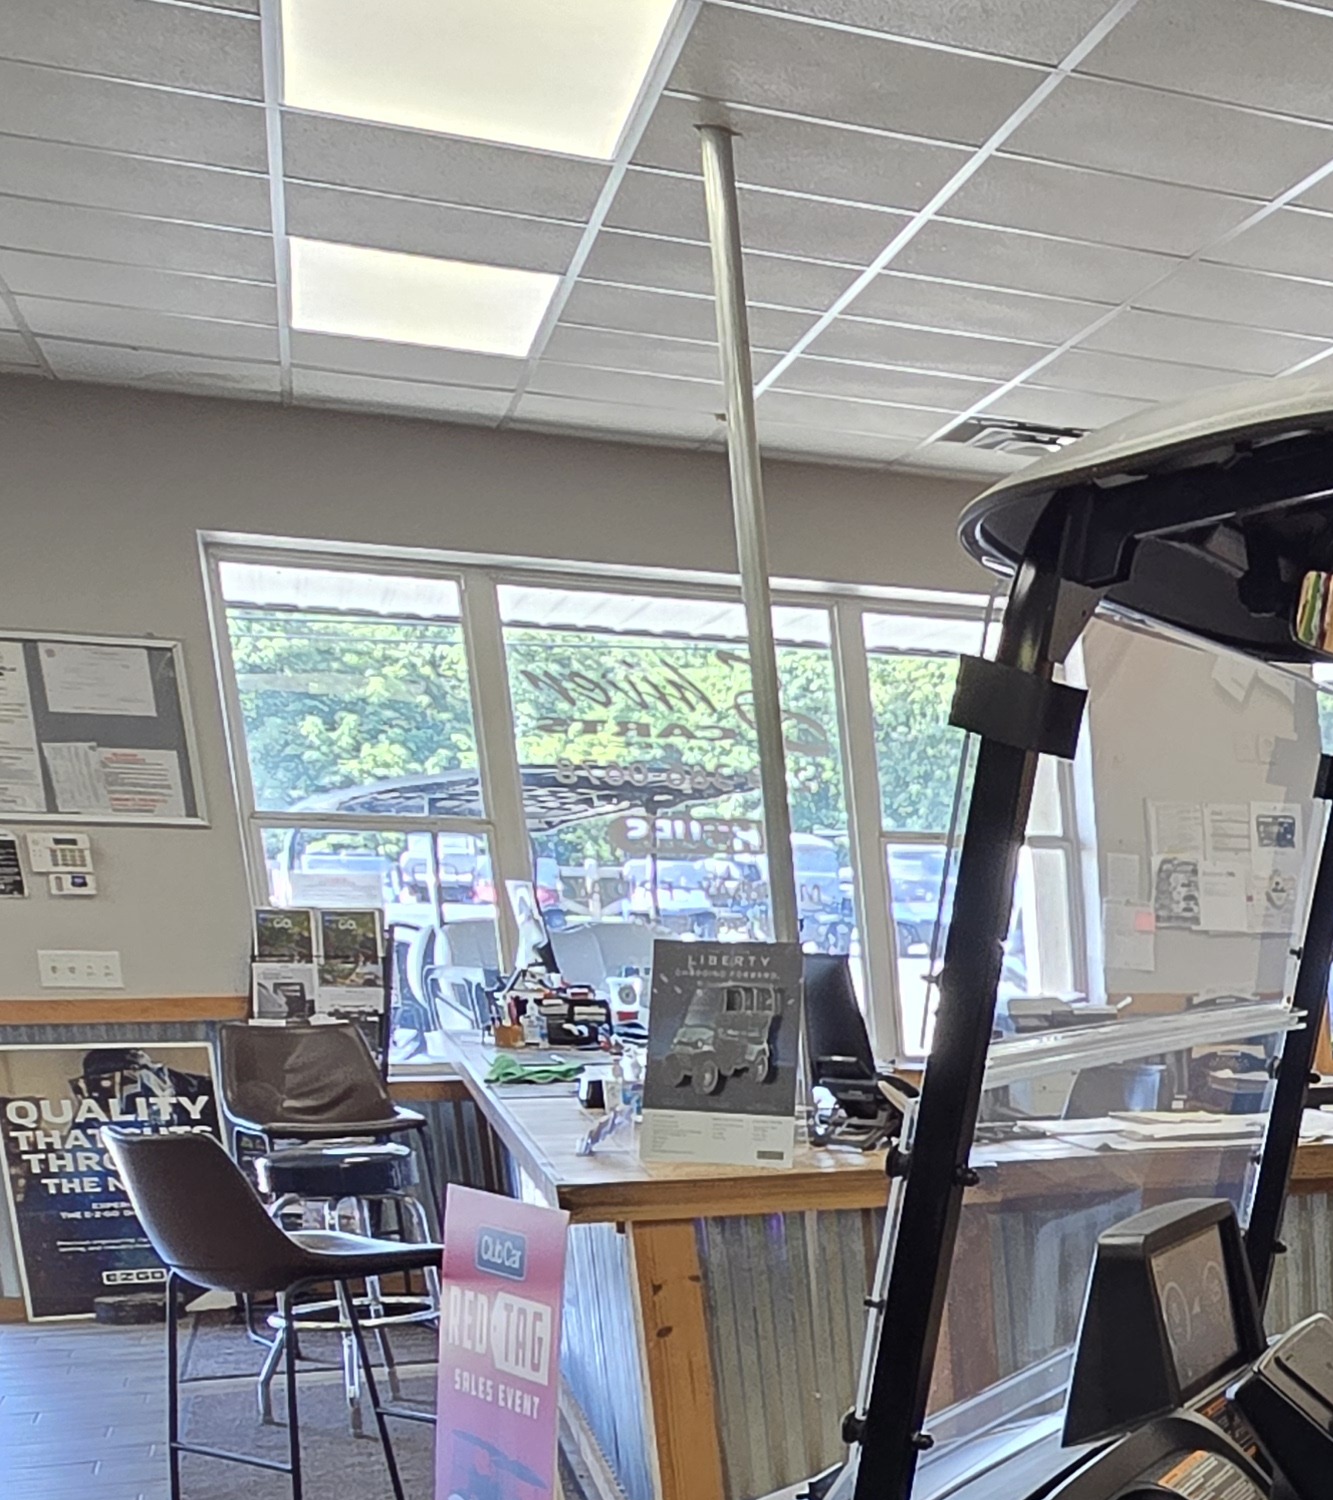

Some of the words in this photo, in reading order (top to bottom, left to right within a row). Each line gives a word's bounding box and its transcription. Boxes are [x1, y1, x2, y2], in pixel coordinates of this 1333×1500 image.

[688, 955, 770, 967] LIBERTY
[5, 1096, 209, 1128] QUALITY
[9, 1128, 104, 1151] THAT
[41, 1177, 102, 1194] THE
[449, 1286, 489, 1355] RED
[503, 1302, 544, 1373] TAG
[455, 1368, 493, 1403] SALES
[498, 1384, 540, 1420] EVENT
